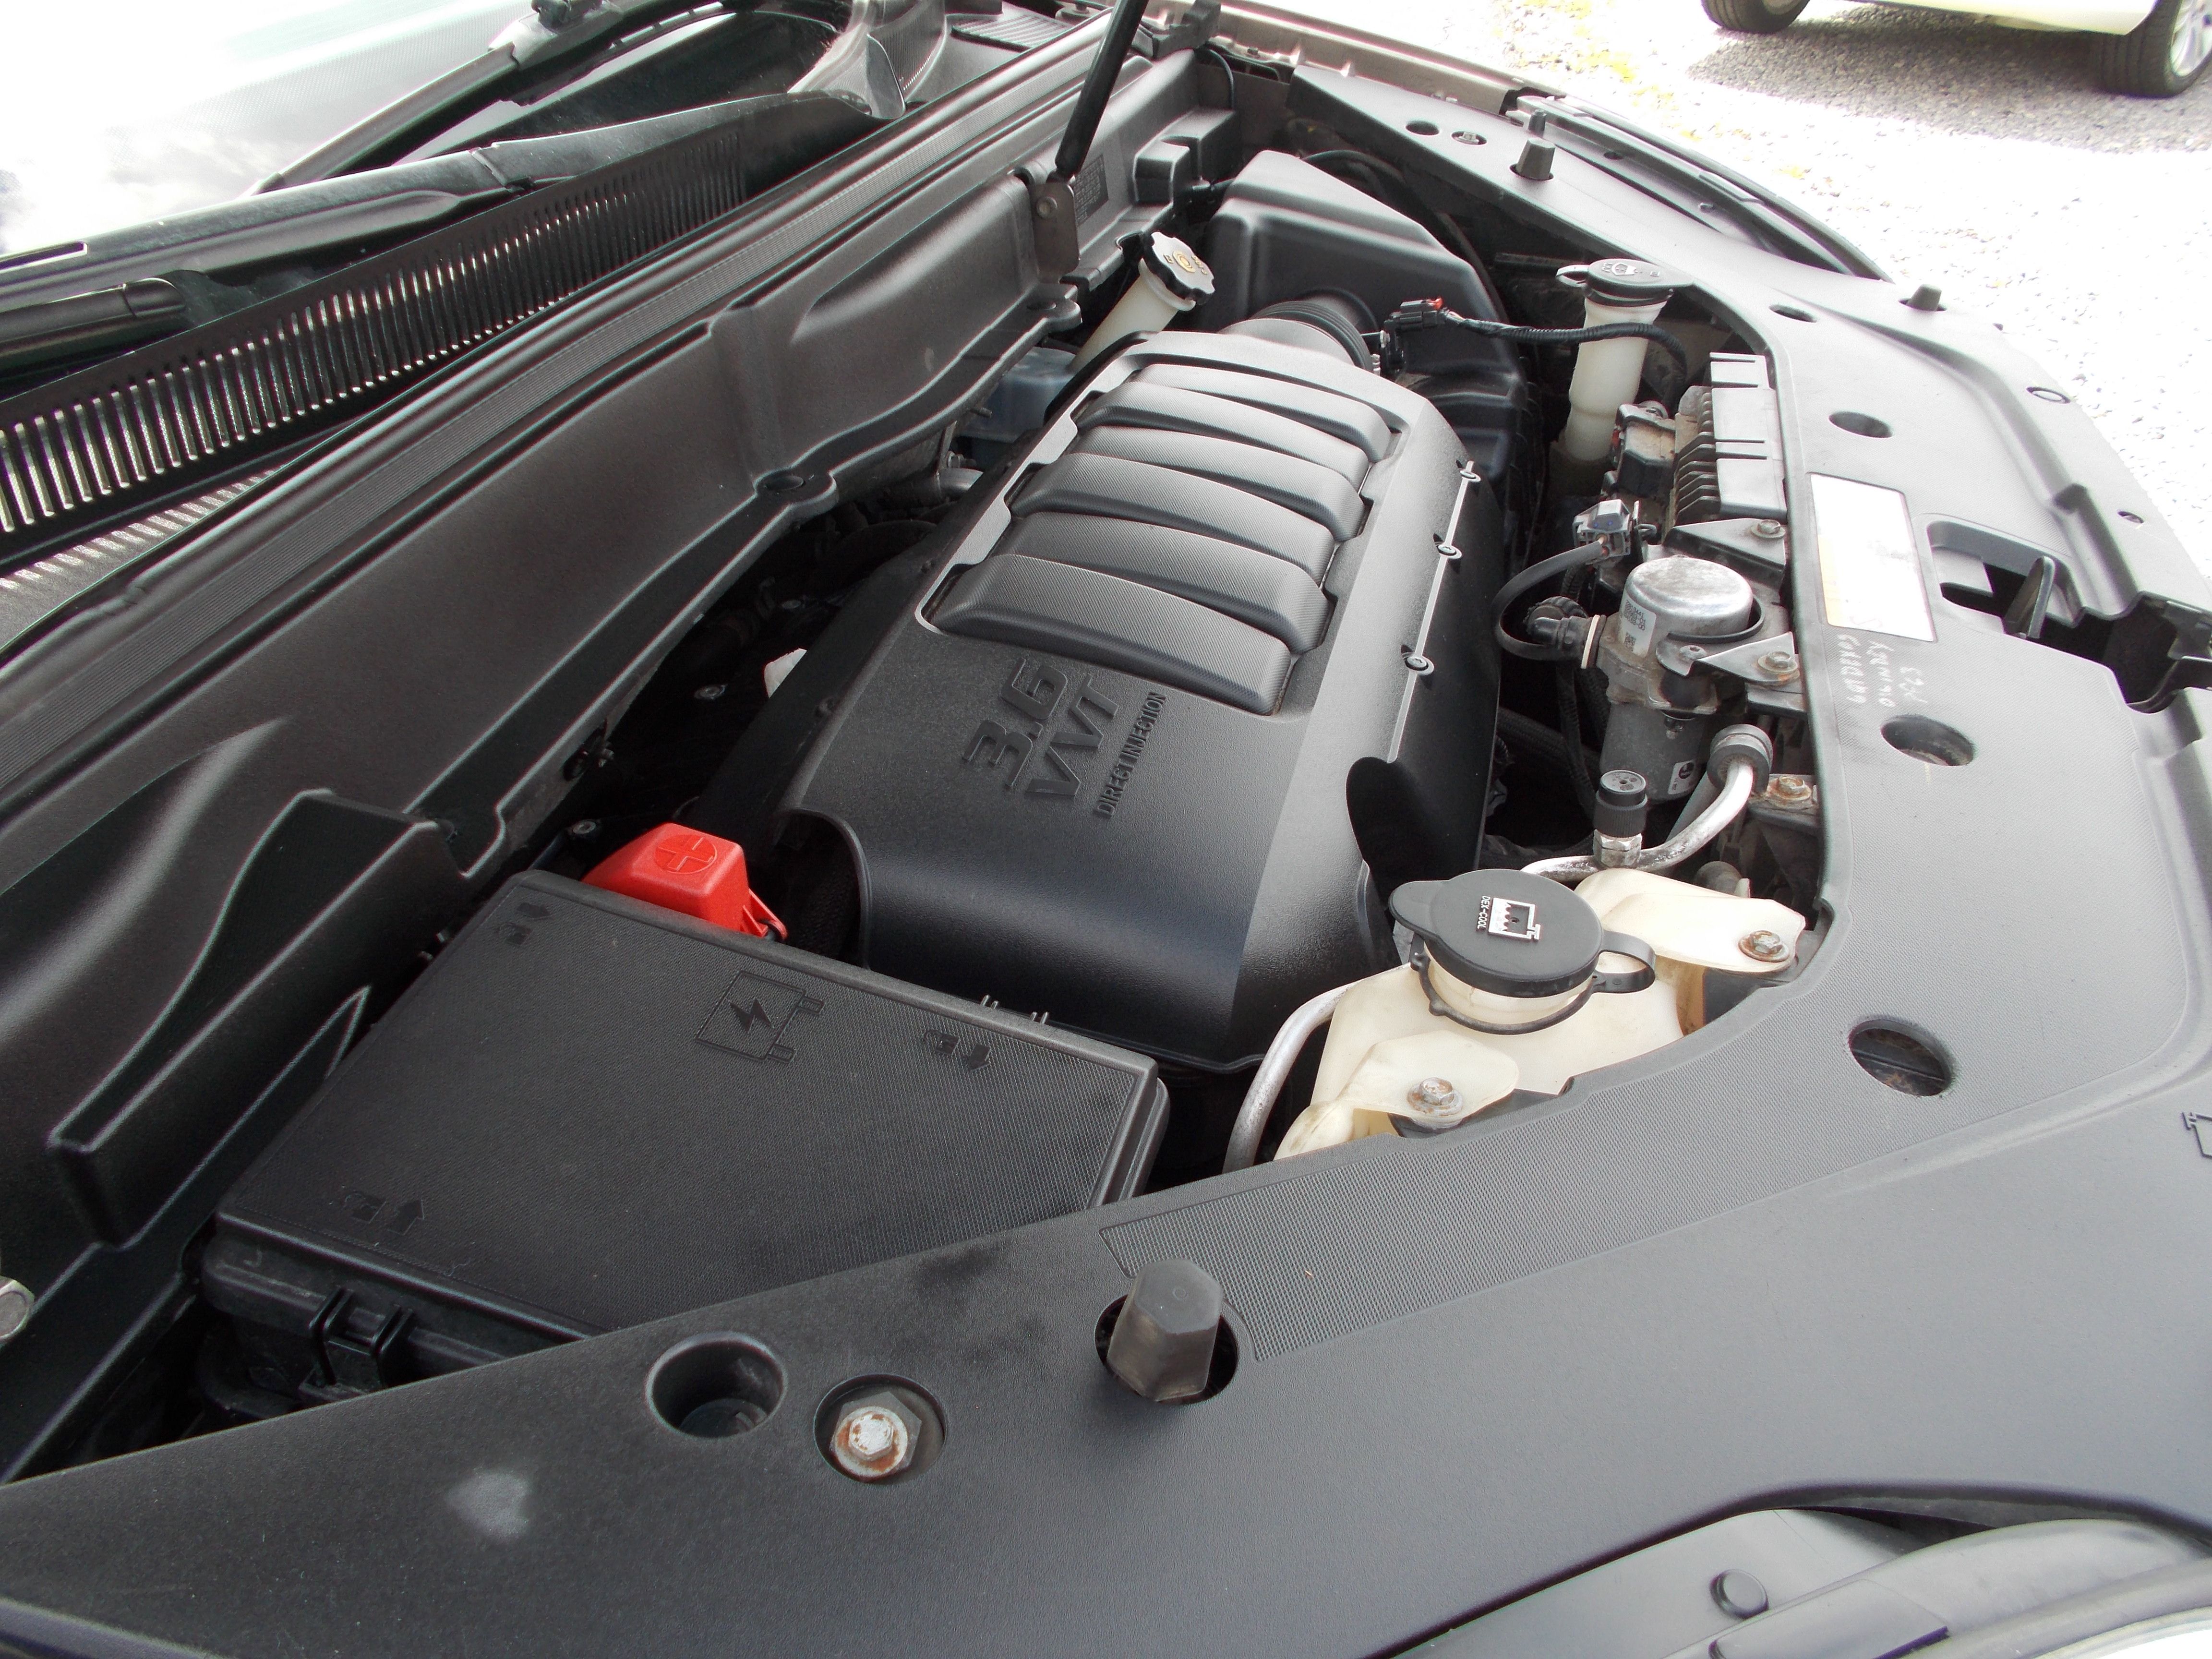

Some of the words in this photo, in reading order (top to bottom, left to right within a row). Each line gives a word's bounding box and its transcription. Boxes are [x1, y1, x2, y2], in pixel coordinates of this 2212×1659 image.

[962, 657, 1068, 788] 3.6
[1025, 674, 1119, 796] VVT
[1096, 758, 1133, 816] DIRECT
[1120, 692, 1166, 761] INJECTION
[1477, 895, 1491, 930] DEX-COOL
